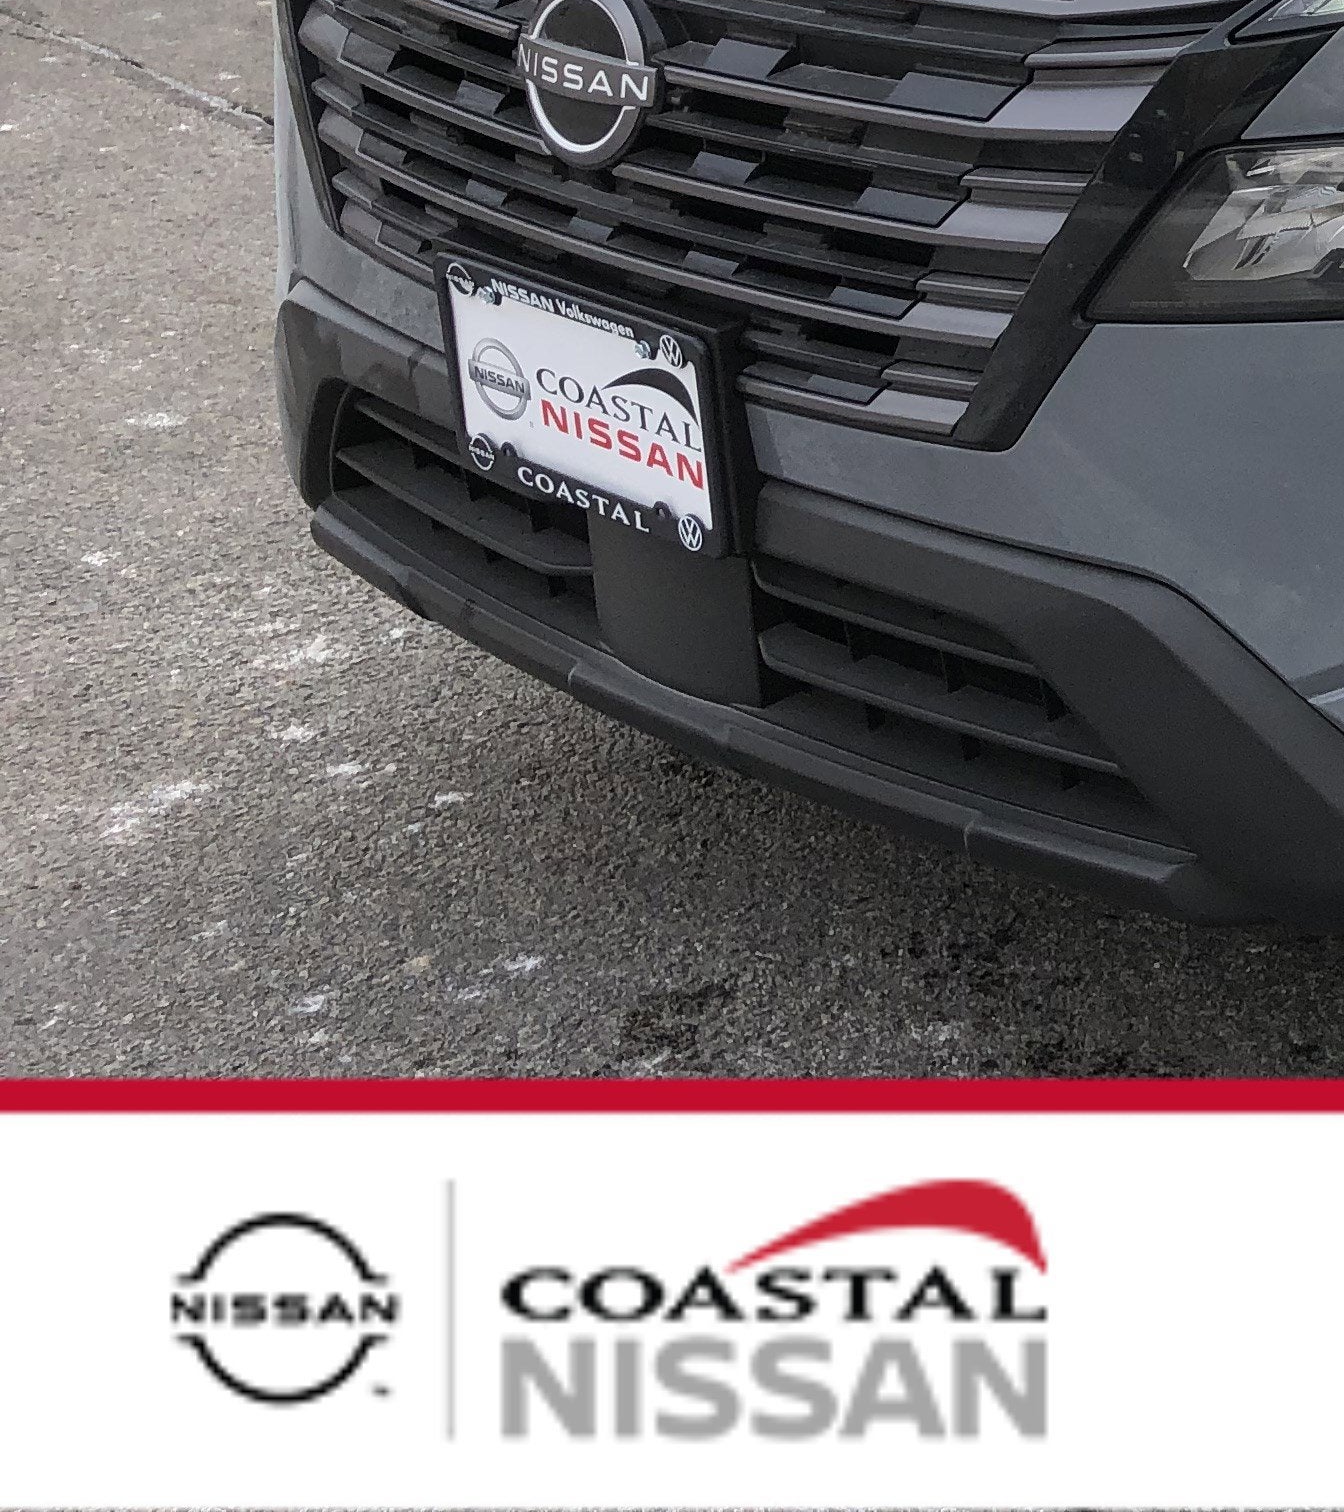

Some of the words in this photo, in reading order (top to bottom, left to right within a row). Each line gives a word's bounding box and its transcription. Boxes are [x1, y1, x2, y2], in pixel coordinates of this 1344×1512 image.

[517, 43, 649, 101] NISSAN
[490, 278, 555, 313] NISSAN
[556, 297, 635, 338] Volkswagen
[473, 366, 525, 394] NISSAN
[535, 368, 702, 453] COASTAL
[540, 399, 704, 490] NISSAN
[517, 466, 650, 533] COASTAL
